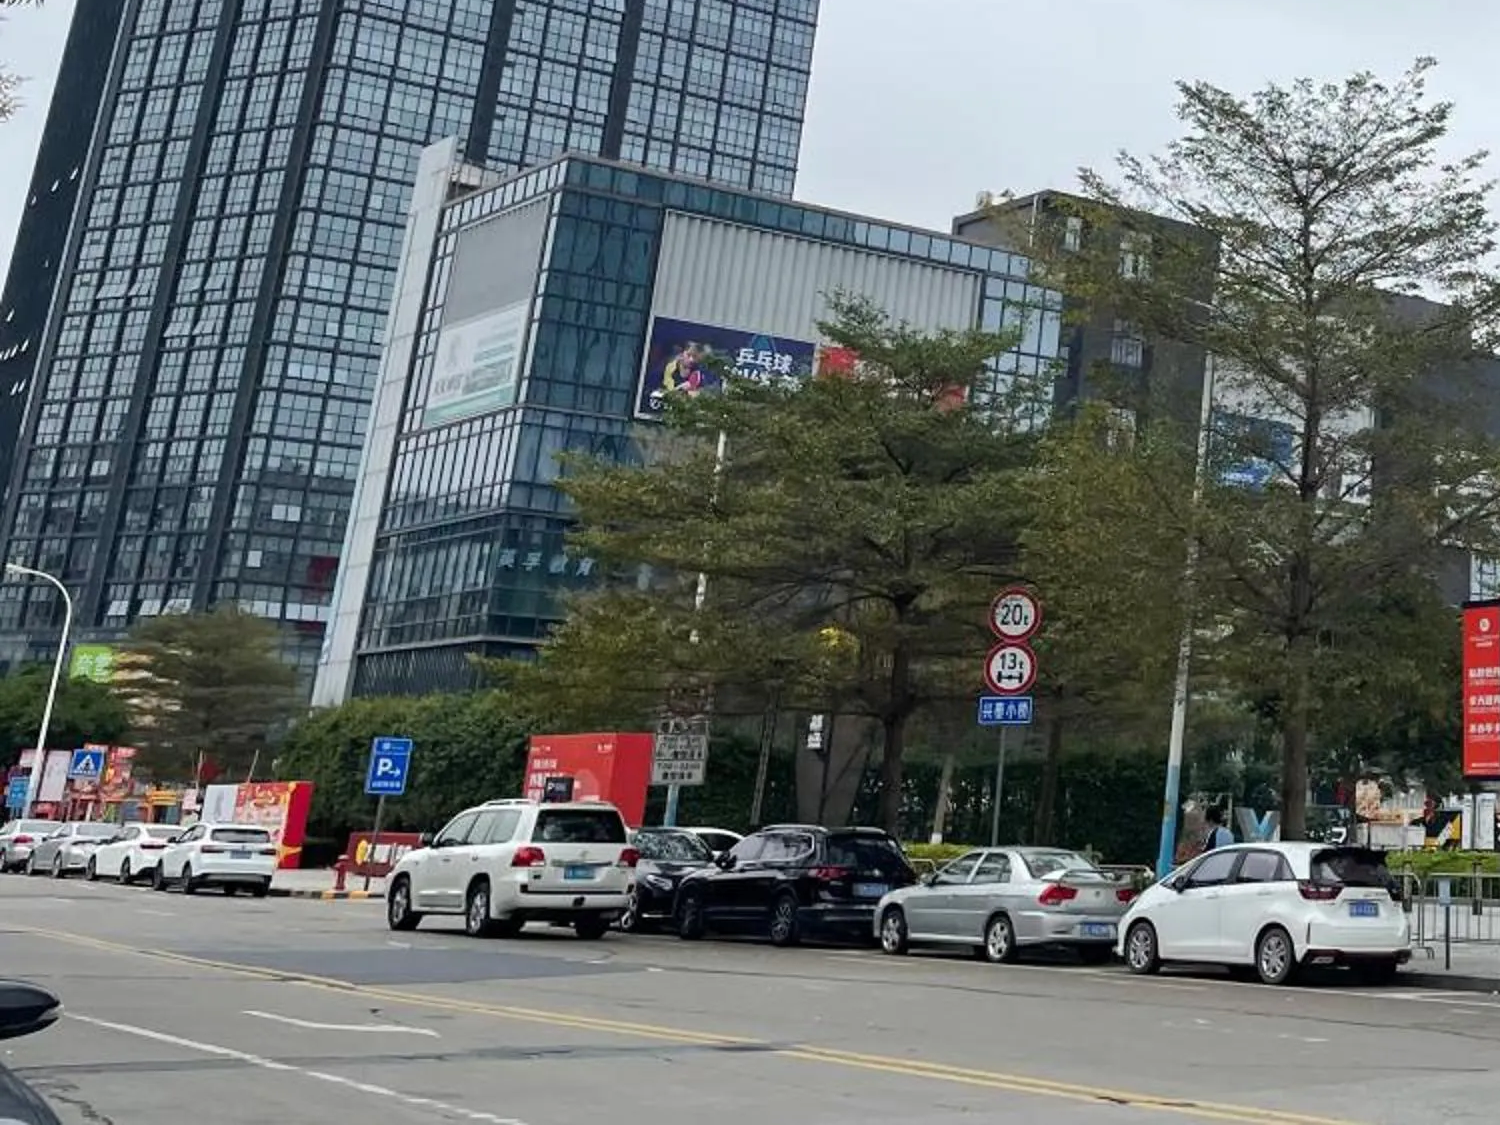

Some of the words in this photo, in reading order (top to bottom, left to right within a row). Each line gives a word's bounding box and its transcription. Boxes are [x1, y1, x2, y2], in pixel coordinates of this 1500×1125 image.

[736, 348, 793, 374] 乒乓球
[1000, 603, 1029, 626] 20t
[999, 652, 1024, 670] 13t
